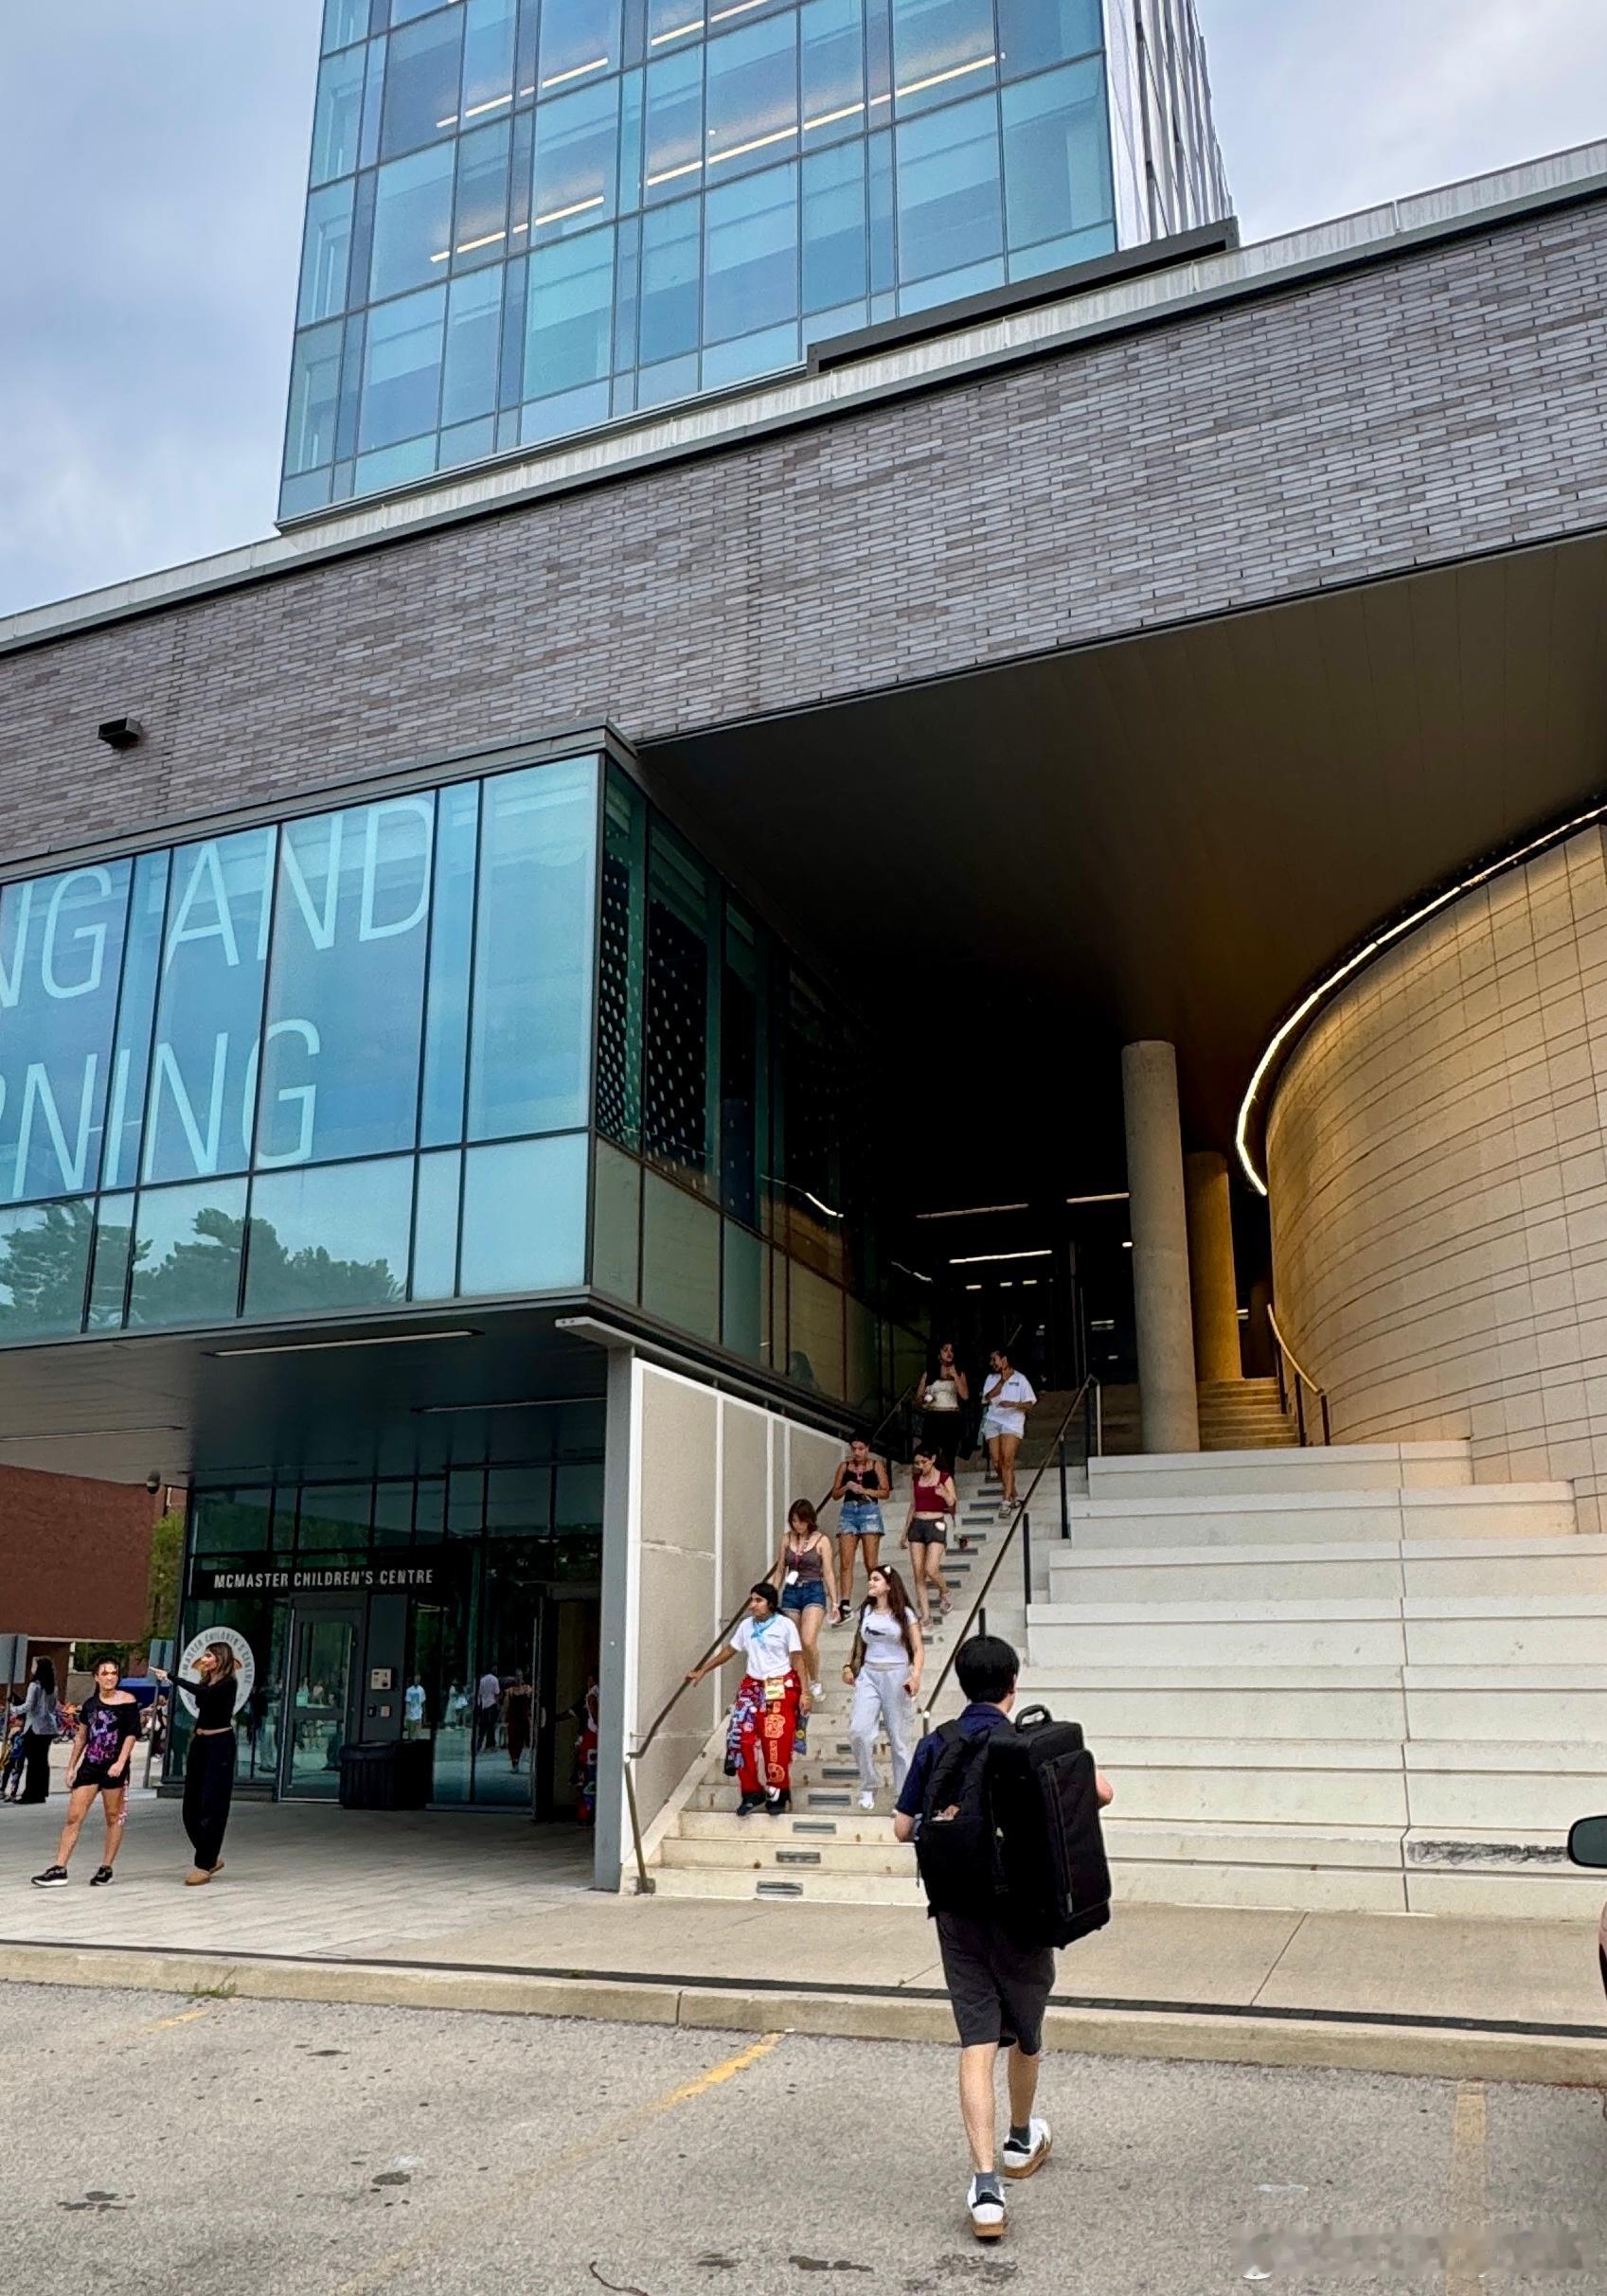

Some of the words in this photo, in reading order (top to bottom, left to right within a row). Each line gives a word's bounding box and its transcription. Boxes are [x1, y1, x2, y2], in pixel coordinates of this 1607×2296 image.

[165, 797, 435, 976] AND
[0, 1019, 320, 1198] NING
[214, 1572, 289, 1589] MCMASTER
[294, 1570, 374, 1587] CHILDREN'S
[380, 1569, 434, 1585] CENTRE
